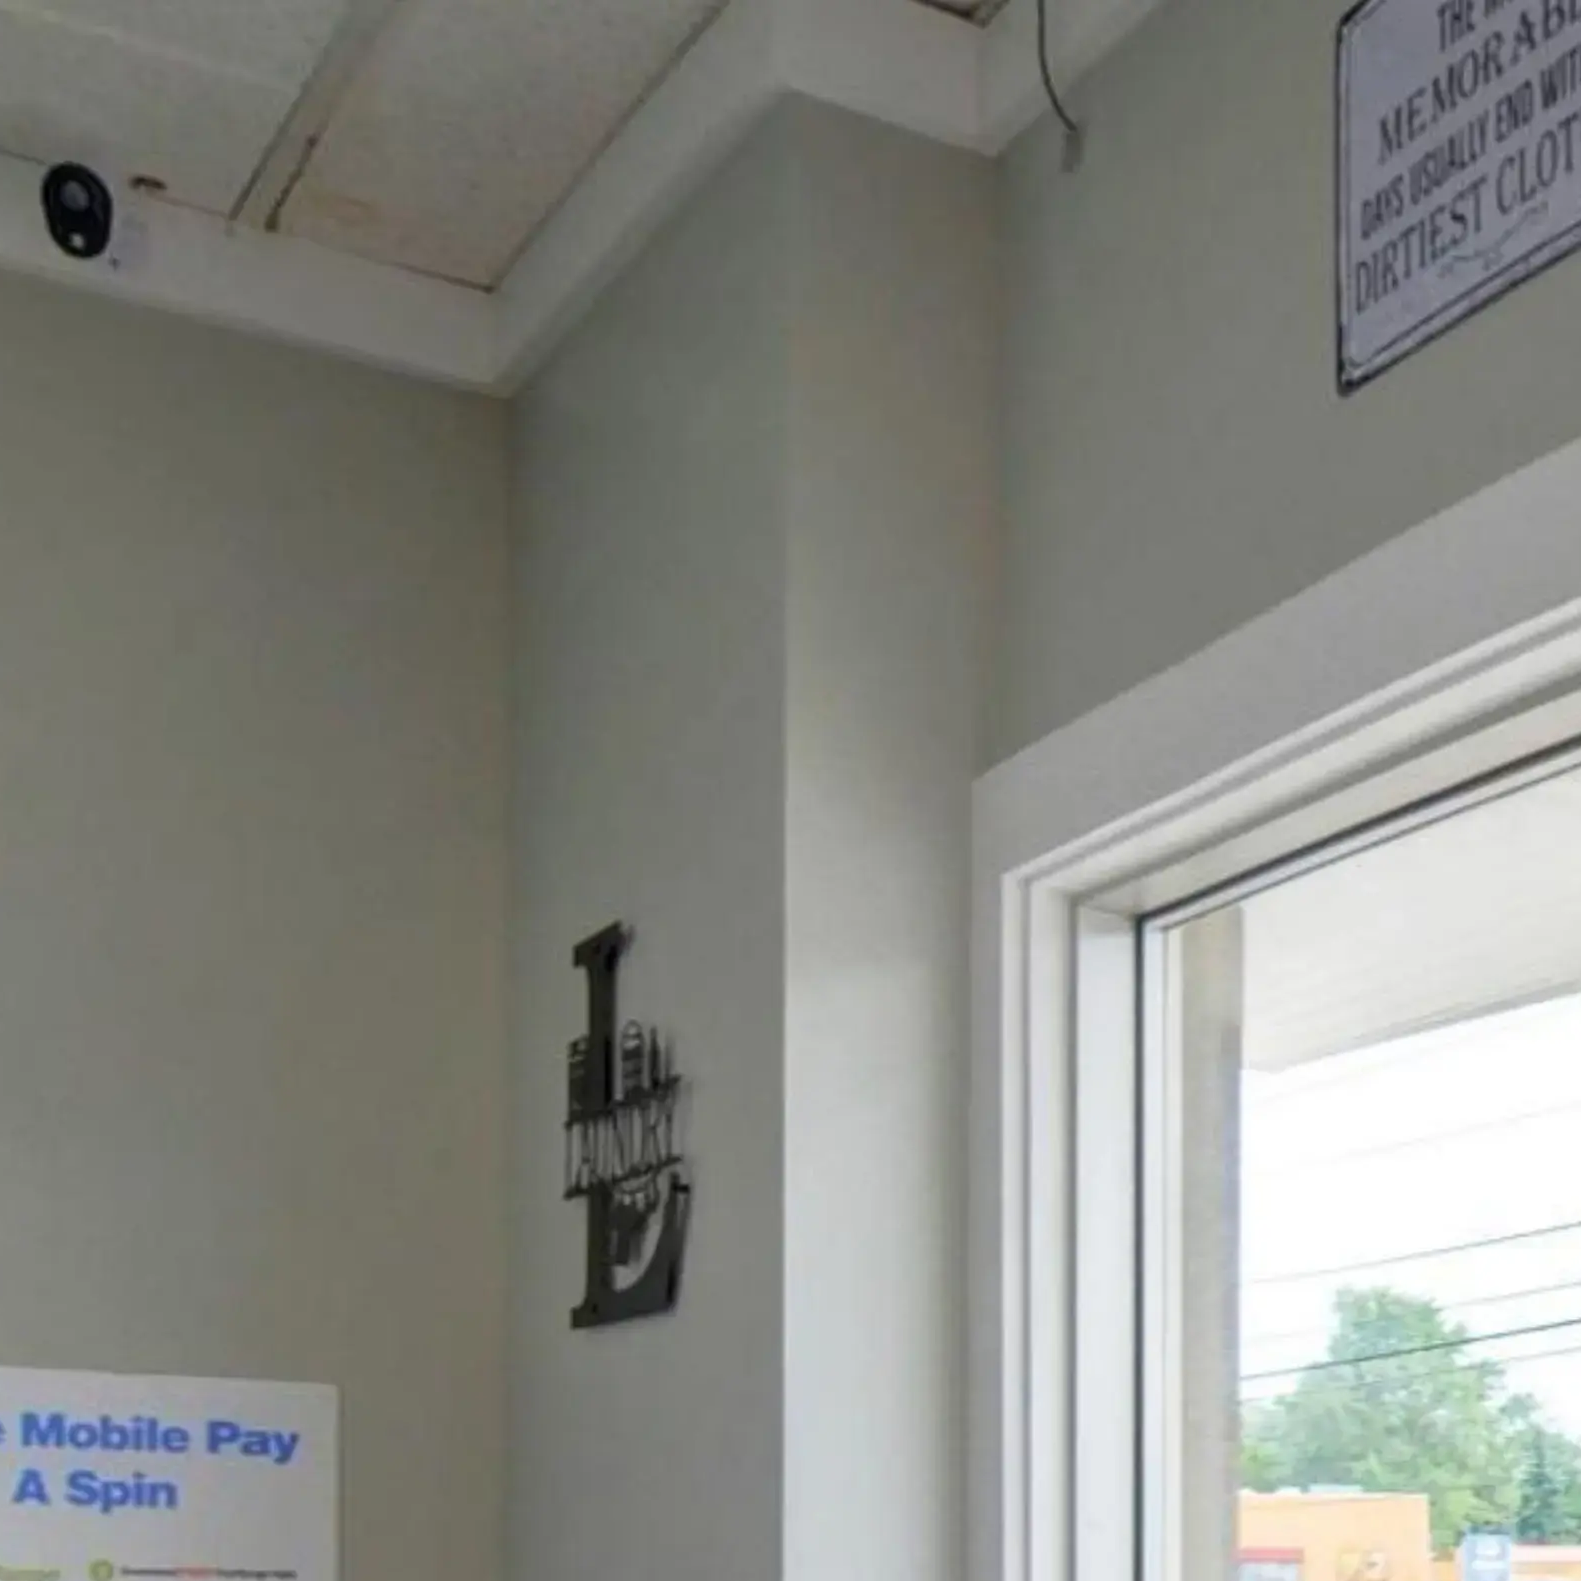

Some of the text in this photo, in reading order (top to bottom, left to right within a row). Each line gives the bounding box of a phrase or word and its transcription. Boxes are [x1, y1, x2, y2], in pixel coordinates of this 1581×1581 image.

[1360, 172, 1405, 241] DAYS
[1407, 110, 1490, 206] USUALLY
[1495, 78, 1535, 144] END
[1355, 173, 1488, 316] DIRTIEST
[21, 1411, 191, 1453] Mobile
[206, 1420, 301, 1464] Pay
[12, 1469, 179, 1514] A Spin
